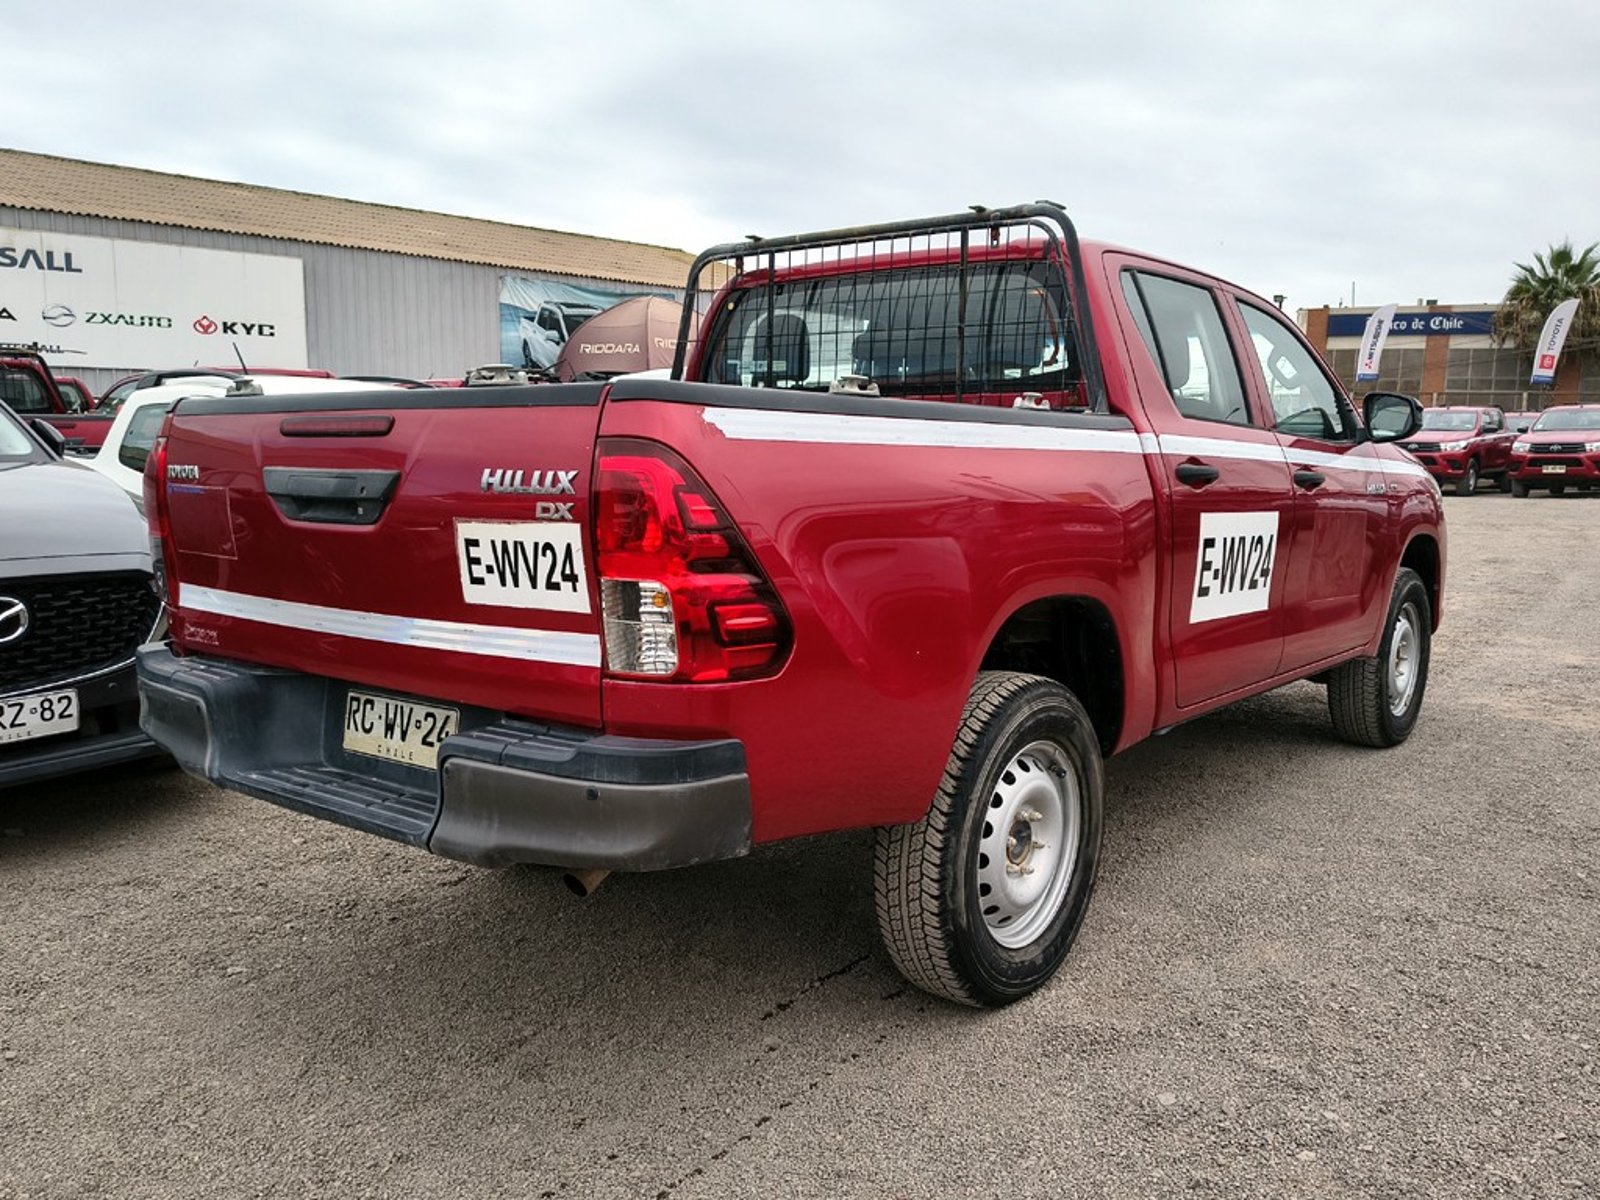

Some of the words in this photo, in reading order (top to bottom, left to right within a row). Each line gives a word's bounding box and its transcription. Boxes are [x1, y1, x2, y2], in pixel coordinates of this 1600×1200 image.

[85, 312, 173, 328] ZXAUTO
[1411, 318, 1426, 330] de
[1430, 316, 1465, 331] Chile
[222, 321, 276, 337] KYC
[1547, 317, 1564, 351] TOYOTA
[167, 464, 200, 479] TOYOTA
[480, 468, 579, 495] HILUX
[535, 502, 575, 520] DX
[464, 538, 579, 593] E-WV24
[1197, 534, 1274, 598] E-WV24
[377, 744, 414, 761] CHILE
